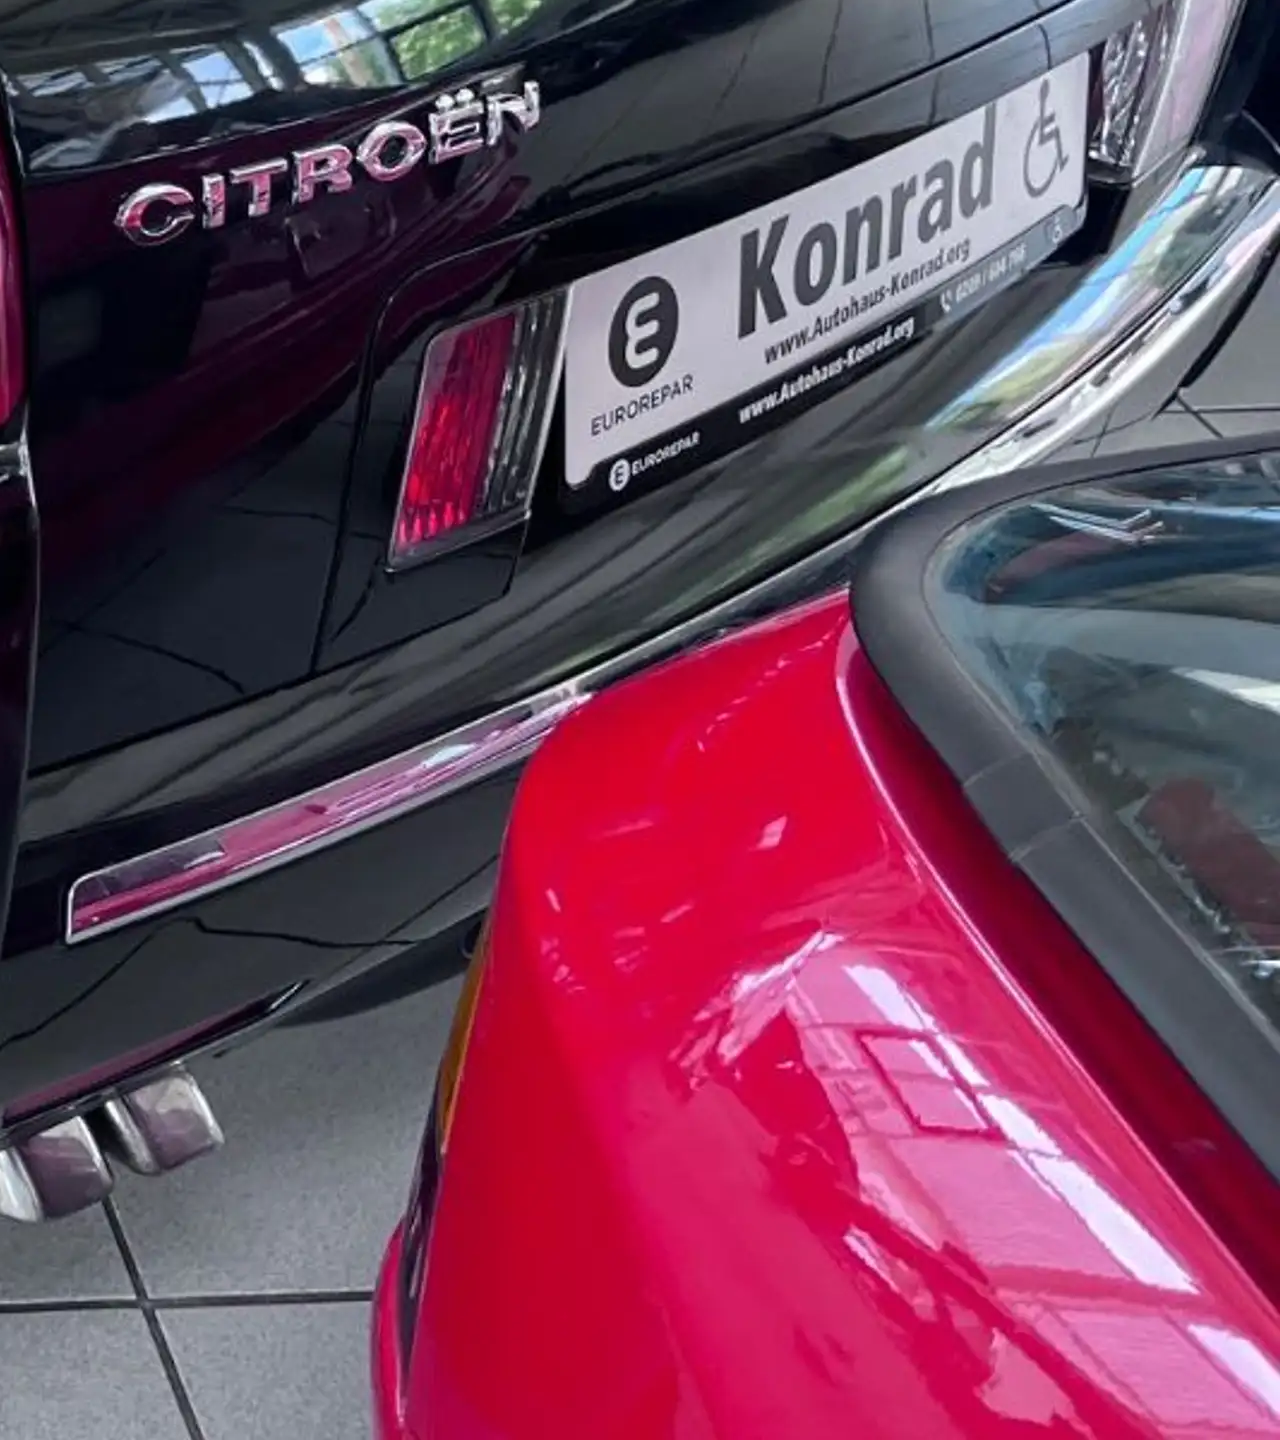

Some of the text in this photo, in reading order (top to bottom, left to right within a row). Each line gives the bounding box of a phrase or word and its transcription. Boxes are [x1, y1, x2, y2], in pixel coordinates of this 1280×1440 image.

[115, 80, 540, 246] CITROËN
[738, 100, 997, 340] Konrad
[764, 237, 971, 365] www.Autohaus-Konrad.org
[591, 373, 694, 437] EUROREPAR
[739, 316, 916, 424] www.Autohaus-Konrad.org
[631, 431, 701, 476] EUROREPAR
